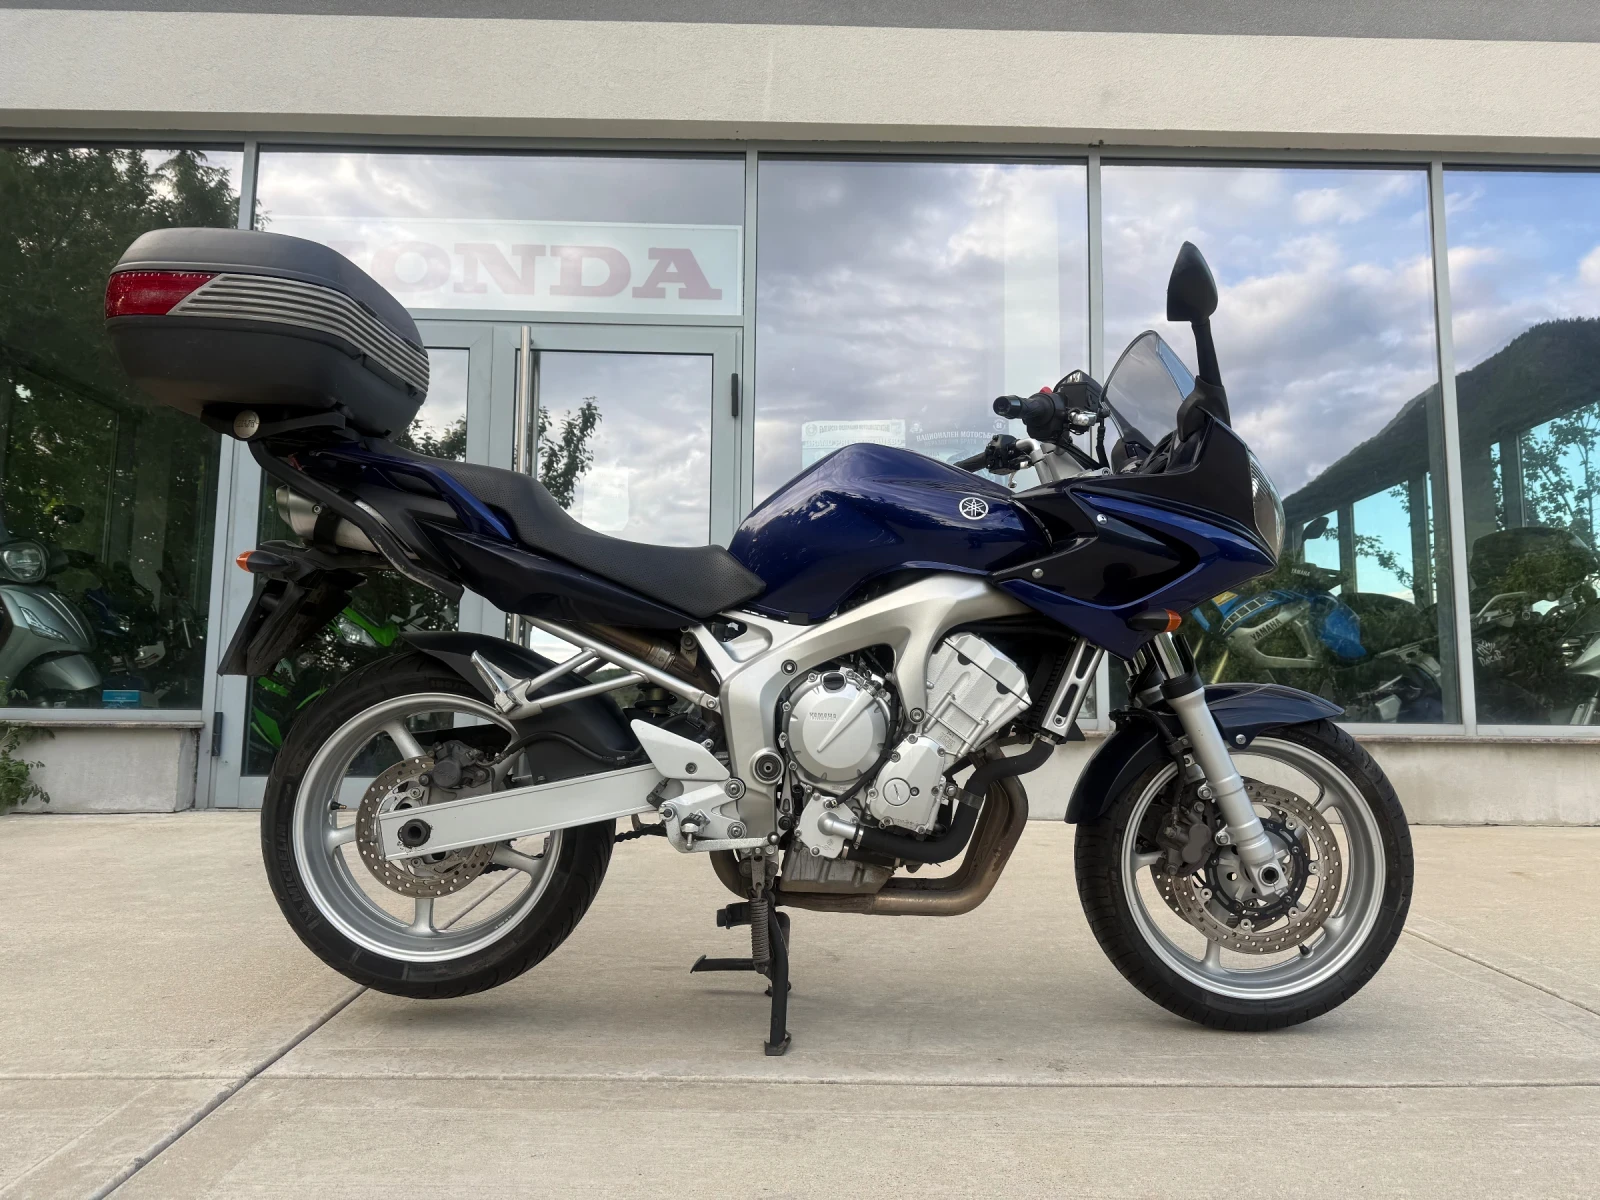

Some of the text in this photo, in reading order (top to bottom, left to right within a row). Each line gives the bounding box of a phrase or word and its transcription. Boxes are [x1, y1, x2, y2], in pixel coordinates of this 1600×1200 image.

[328, 240, 723, 301] ONDA
[1291, 568, 1311, 577] YAMAHA
[1250, 617, 1283, 641] YAMAHA
[809, 711, 837, 720] YAMAHA
[275, 821, 303, 902] MICHELIN
